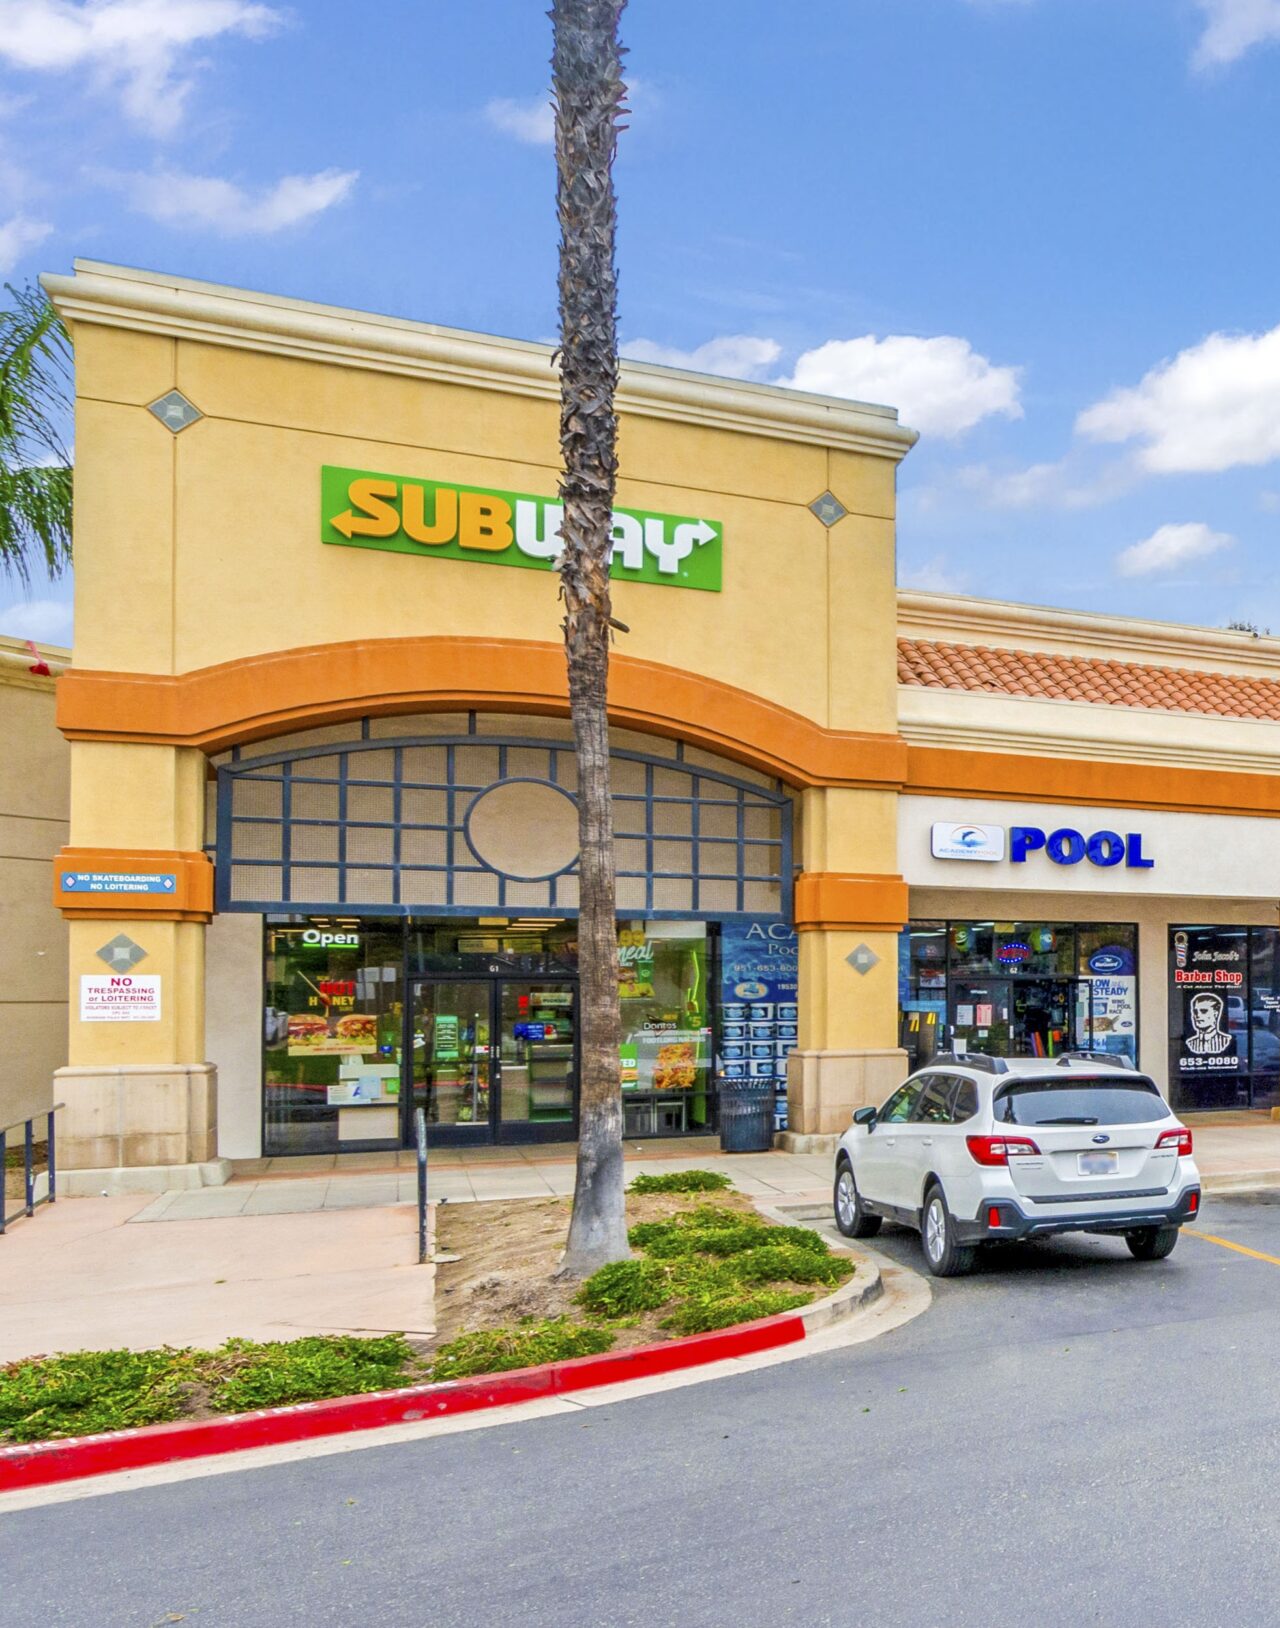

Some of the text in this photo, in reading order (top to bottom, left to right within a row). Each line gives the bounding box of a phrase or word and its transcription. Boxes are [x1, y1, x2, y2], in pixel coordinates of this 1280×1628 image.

[1009, 826, 1155, 868] POOL
[92, 875, 161, 883] SKATEBOARDING
[302, 929, 359, 947] Open
[1192, 950, 1212, 962] John
[110, 978, 133, 987] NO
[1175, 969, 1243, 985] Barber Shop
[1092, 987, 1128, 996] STEADY
[643, 1022, 677, 1030] Doritos
[1180, 1056, 1239, 1067] 653-0080
[0, 1428, 138, 1456] RKING
